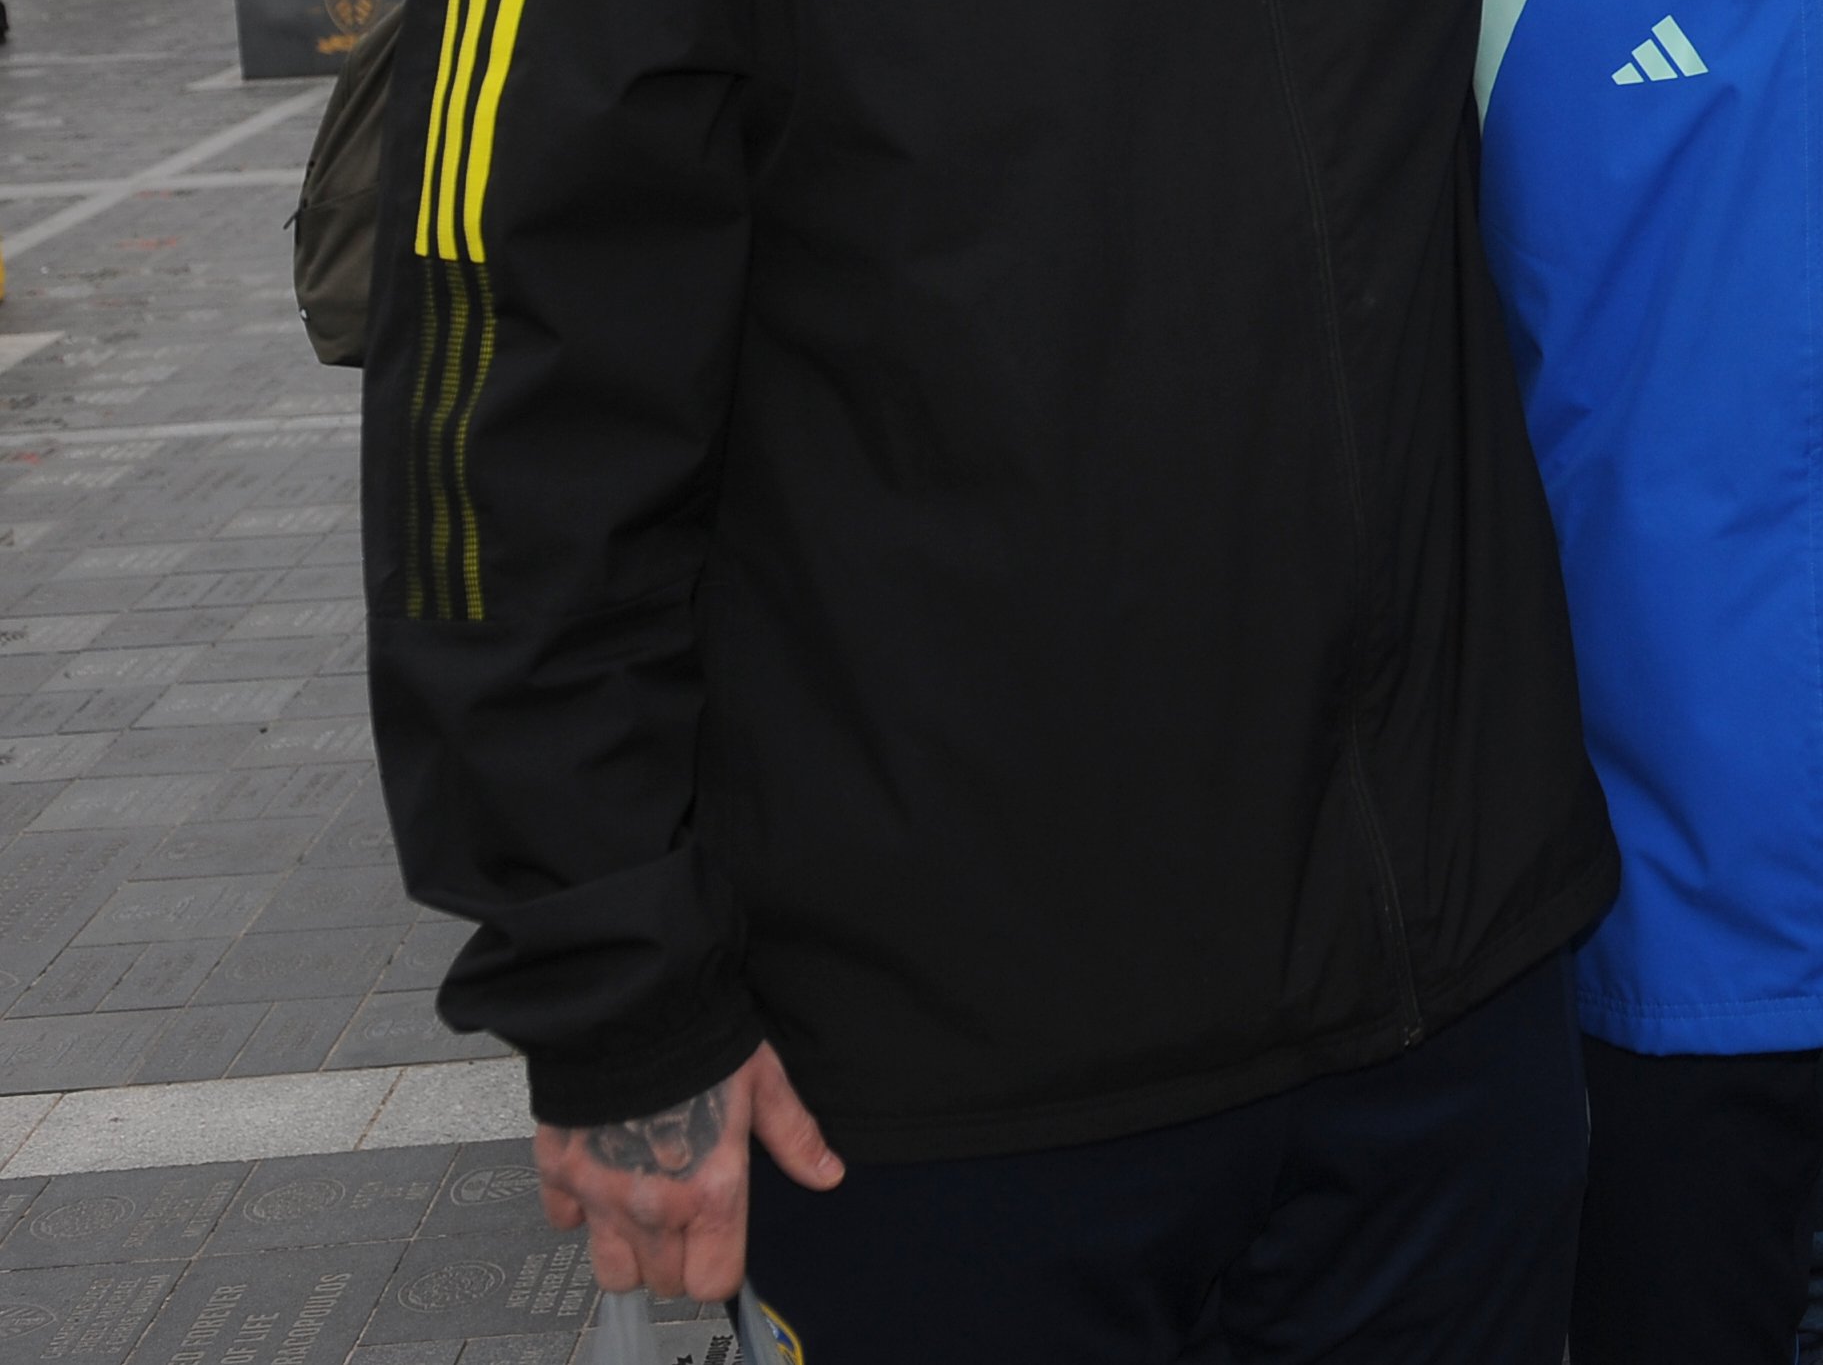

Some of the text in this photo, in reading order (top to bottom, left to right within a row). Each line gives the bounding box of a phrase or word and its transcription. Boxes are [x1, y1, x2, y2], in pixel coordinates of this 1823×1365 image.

[549, 1243, 578, 1270] LEEDS
[178, 1283, 249, 1346] FOREVER
[218, 1311, 282, 1364] OF LIFE
